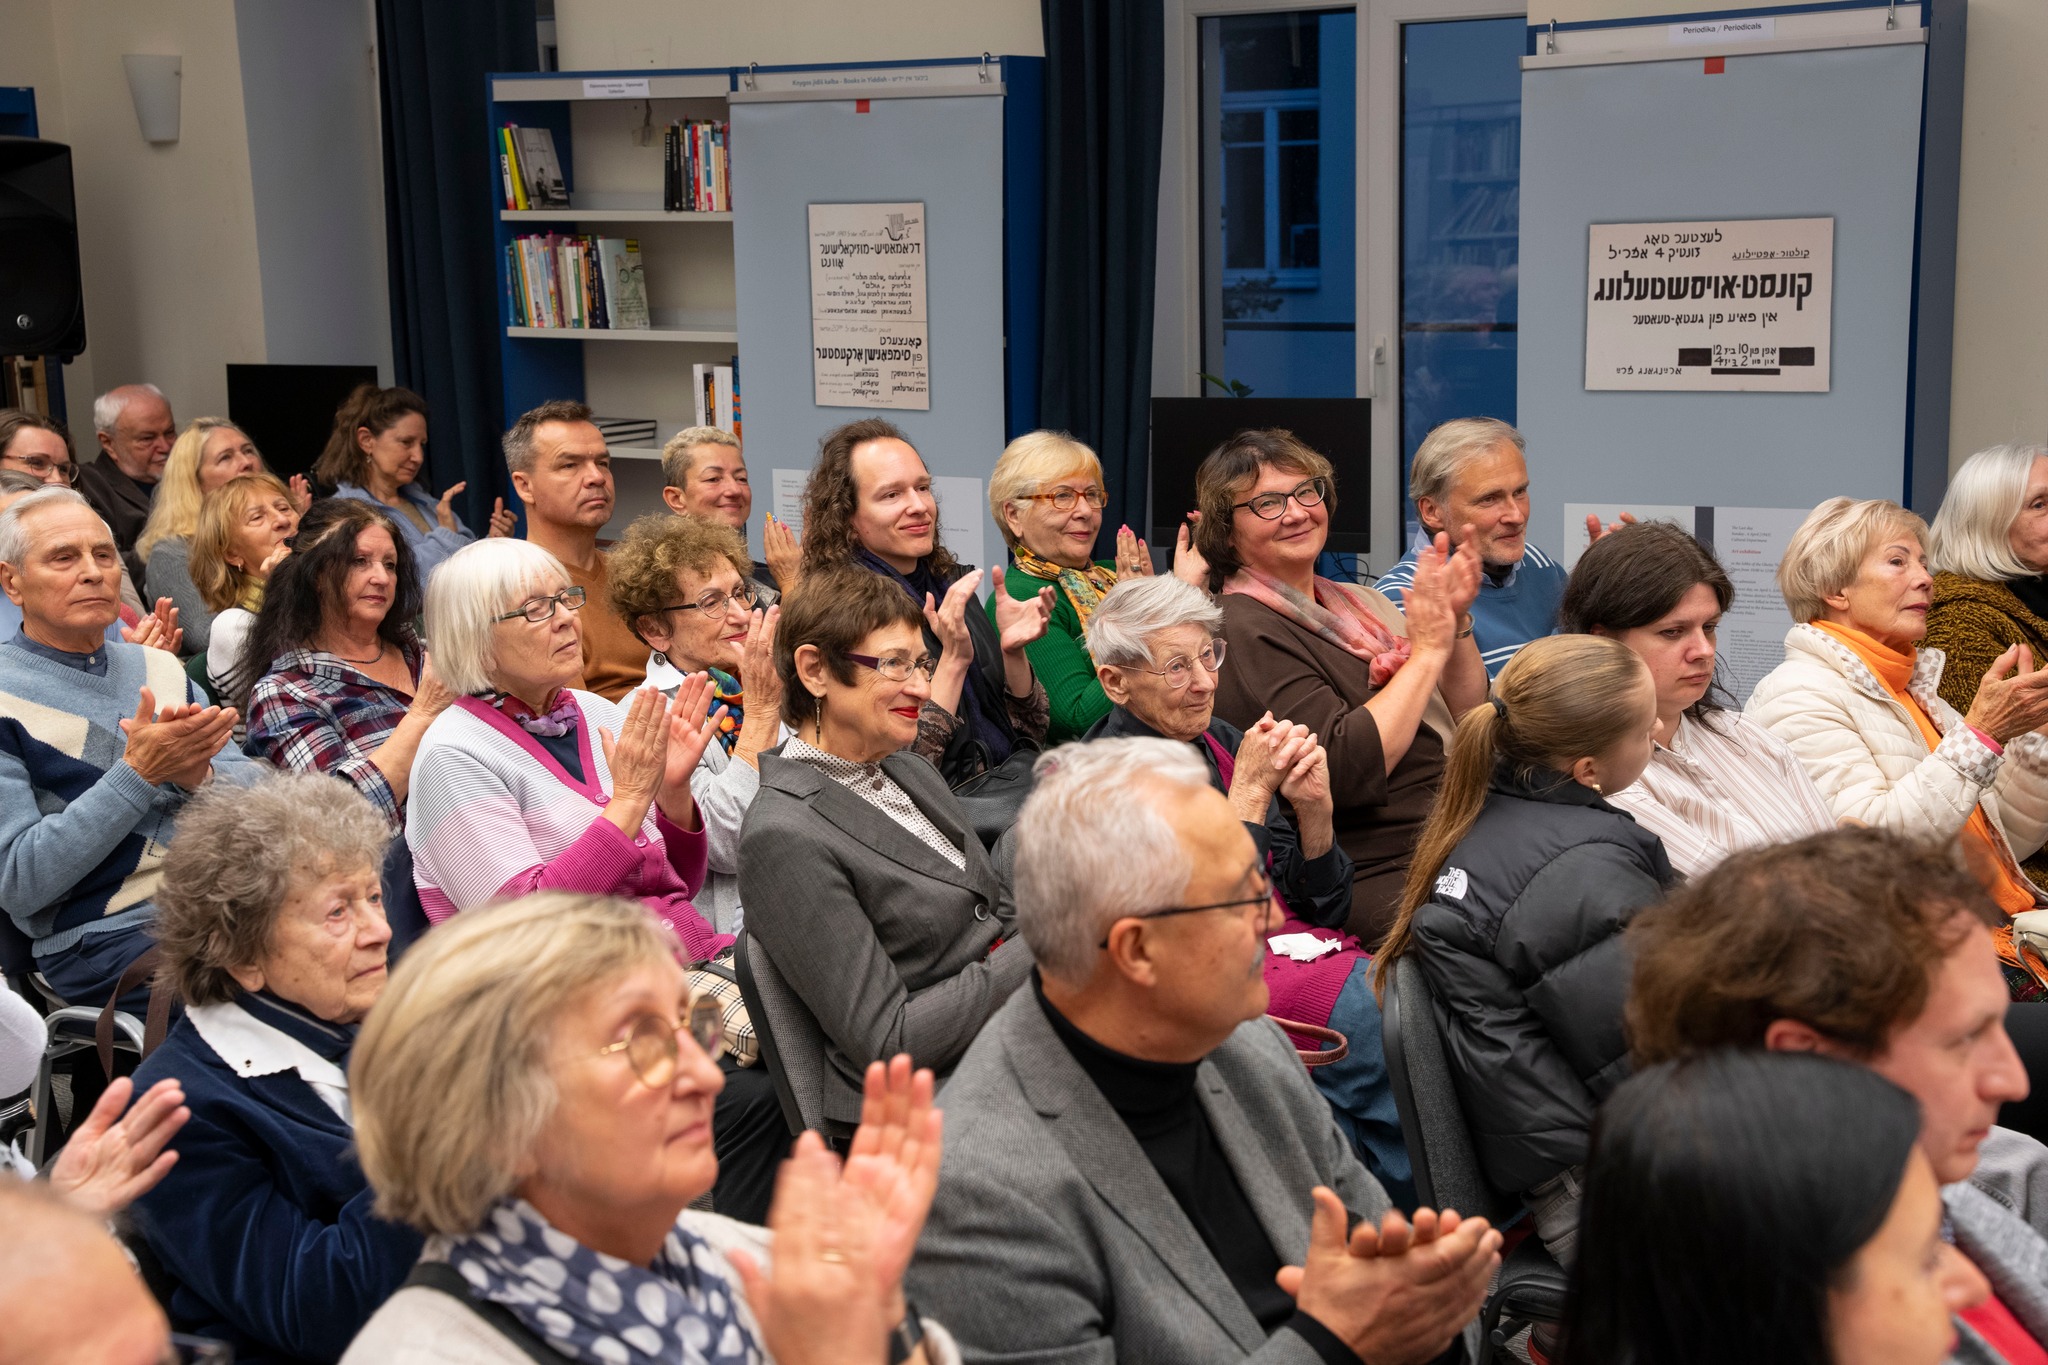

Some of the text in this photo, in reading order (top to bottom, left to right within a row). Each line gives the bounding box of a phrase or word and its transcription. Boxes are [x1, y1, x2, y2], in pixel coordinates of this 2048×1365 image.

[1683, 26, 1716, 34] Periodika
[1723, 22, 1762, 32] Periodicals
[1674, 228, 1723, 243] לעצטער
[1655, 247, 1665, 258] 4
[1593, 270, 1812, 311] קונסט-אויסשטעלונג
[1708, 313, 1724, 330] פון
[1762, 312, 1778, 328] אין
[1713, 344, 1722, 355] 12
[1724, 347, 1736, 355] ביז
[1738, 342, 1749, 355] 10
[912, 354, 923, 366] פון
[1714, 356, 1724, 366] 4
[1740, 355, 1748, 367] 2
[1447, 867, 1461, 878] THE
[1436, 875, 1457, 888] NORTH
[1435, 884, 1454, 895] FACE
